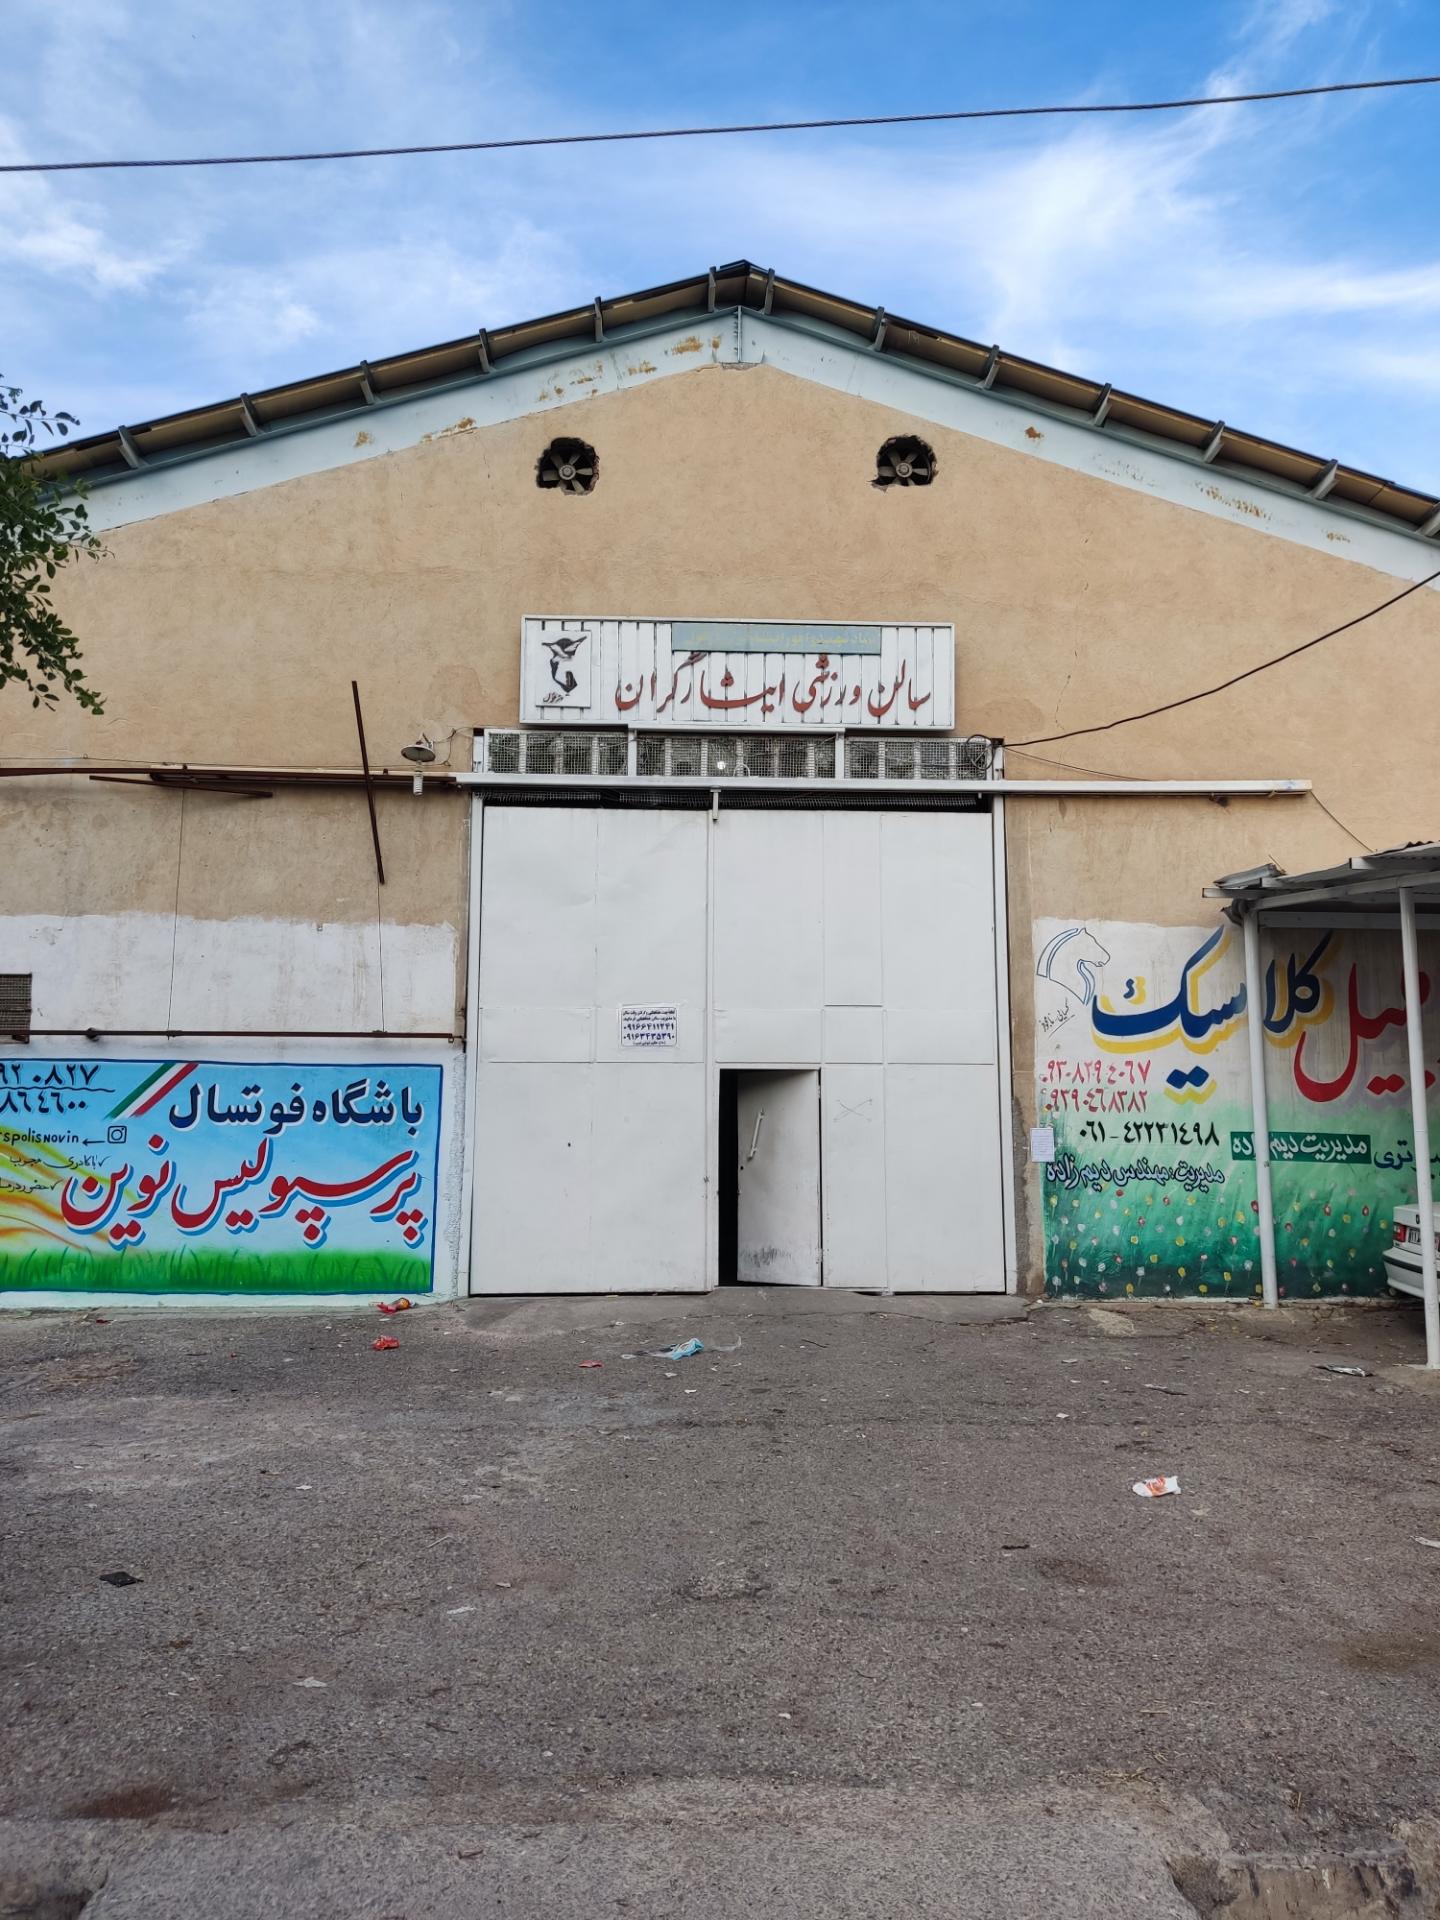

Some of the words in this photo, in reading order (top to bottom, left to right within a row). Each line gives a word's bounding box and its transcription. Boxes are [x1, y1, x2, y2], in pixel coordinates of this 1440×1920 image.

[614, 651, 787, 714] ایثارگران
[792, 652, 862, 714] ورزشی
[866, 658, 931, 718] سالن
[168, 1080, 305, 1135] فوتسال
[311, 1077, 424, 1136] باشگاه
[1112, 1156, 1171, 1188] مهندس
[1300, 1134, 1368, 1162] مدیریت
[60, 1133, 173, 1243] نوین
[171, 1136, 426, 1243] پرسپولیس
